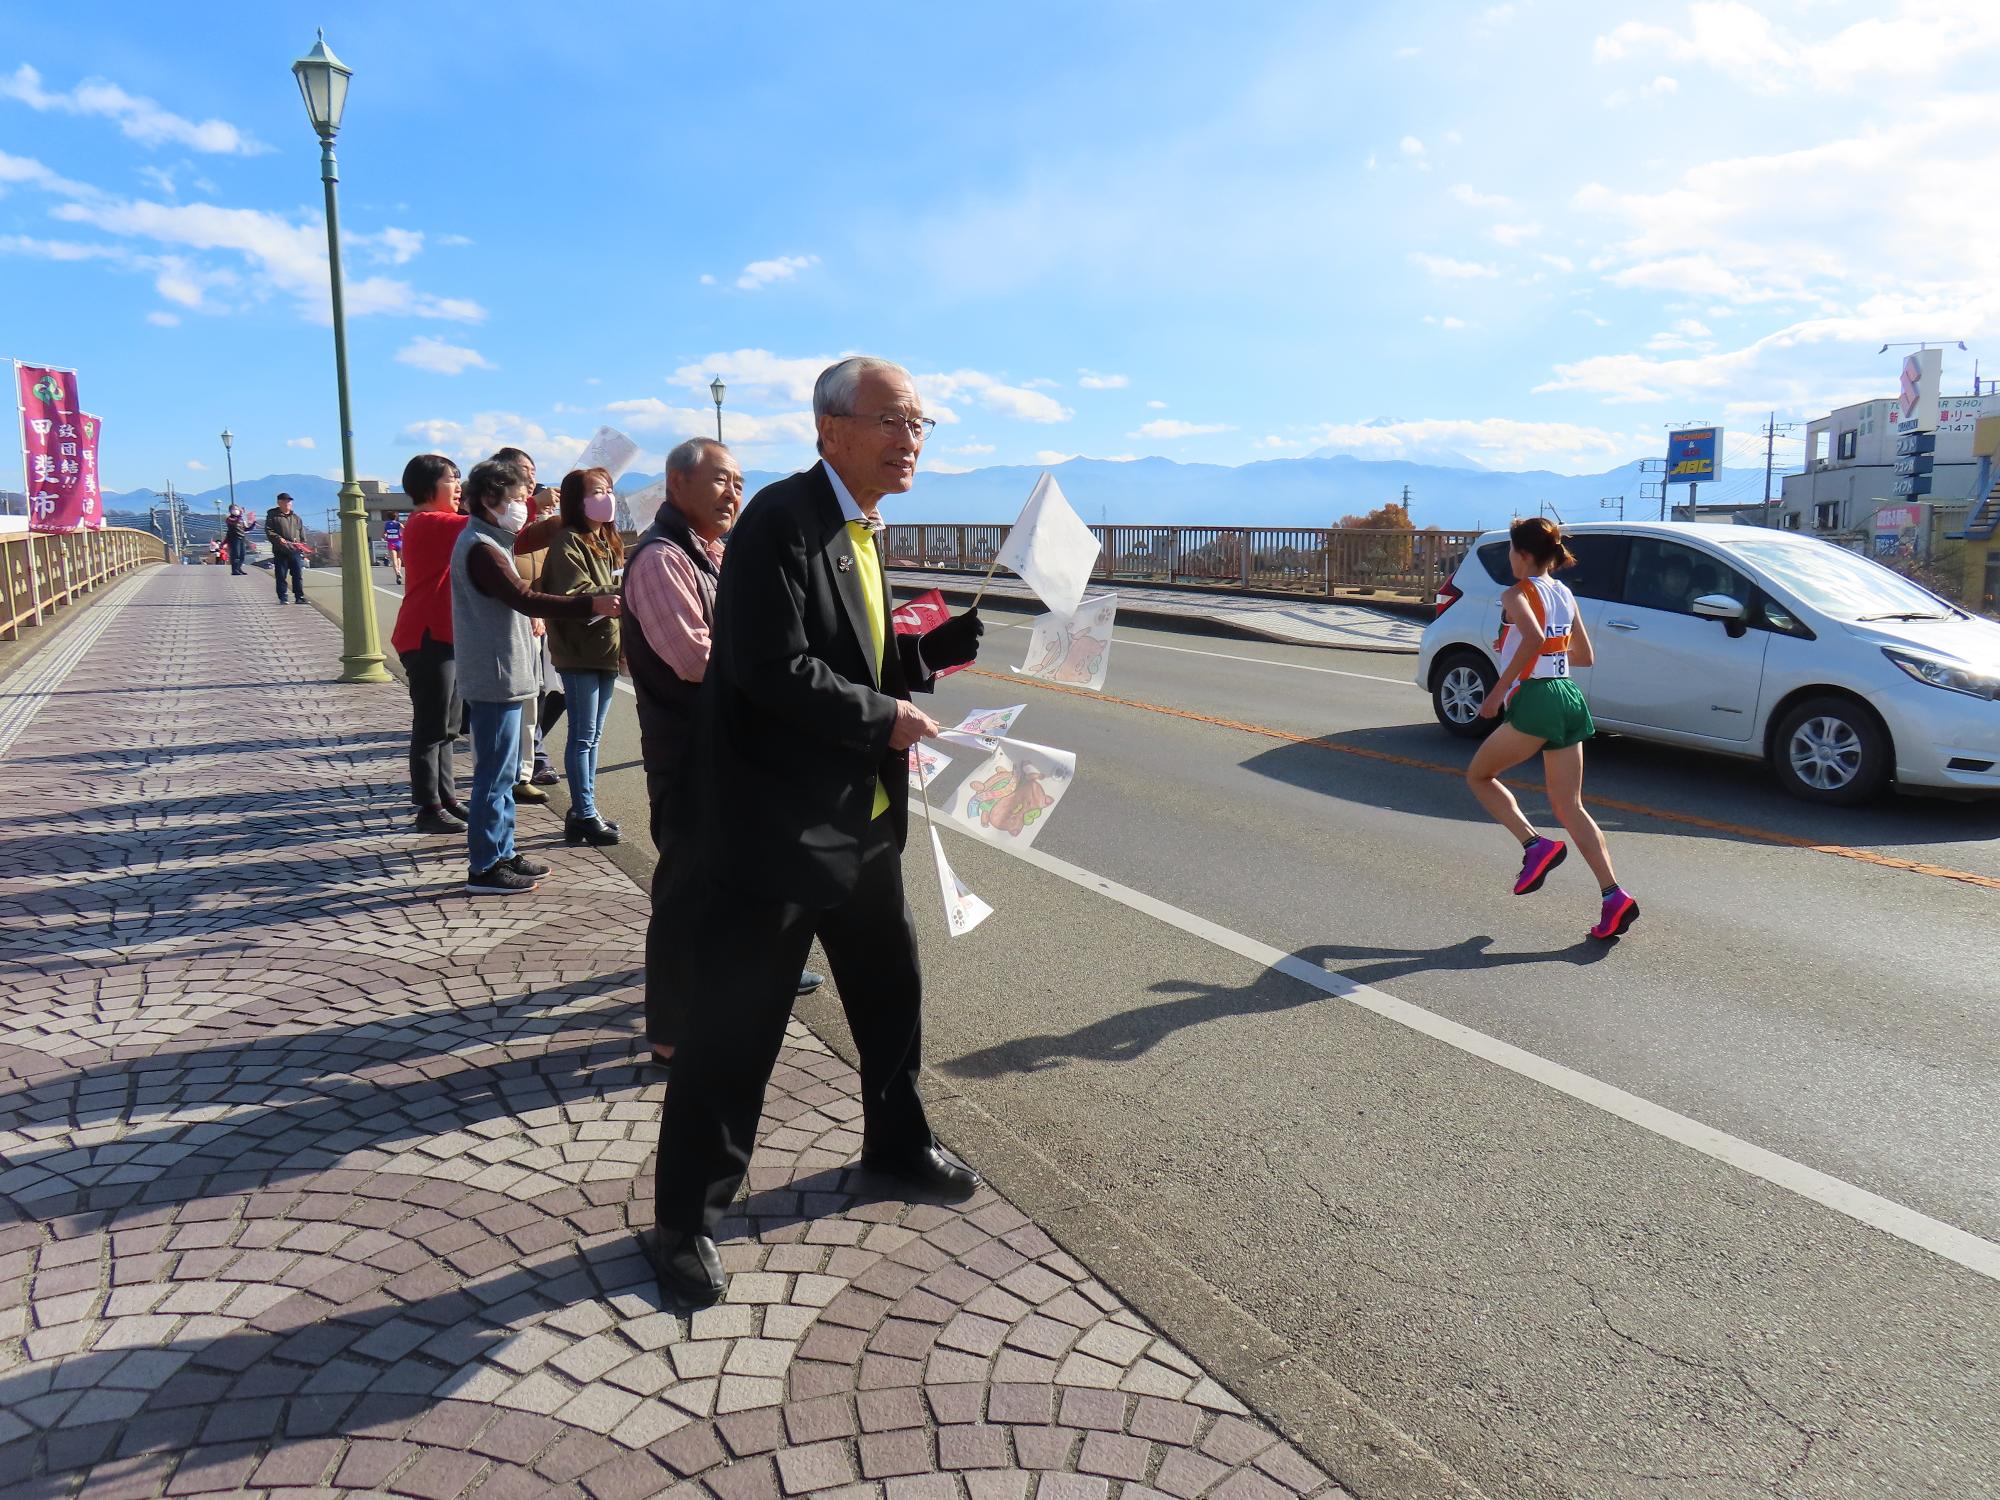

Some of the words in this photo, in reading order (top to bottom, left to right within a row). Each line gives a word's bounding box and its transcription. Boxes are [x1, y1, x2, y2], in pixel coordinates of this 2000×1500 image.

[30, 418, 60, 520] 甲斐市
[1669, 459, 1713, 475] ABC
